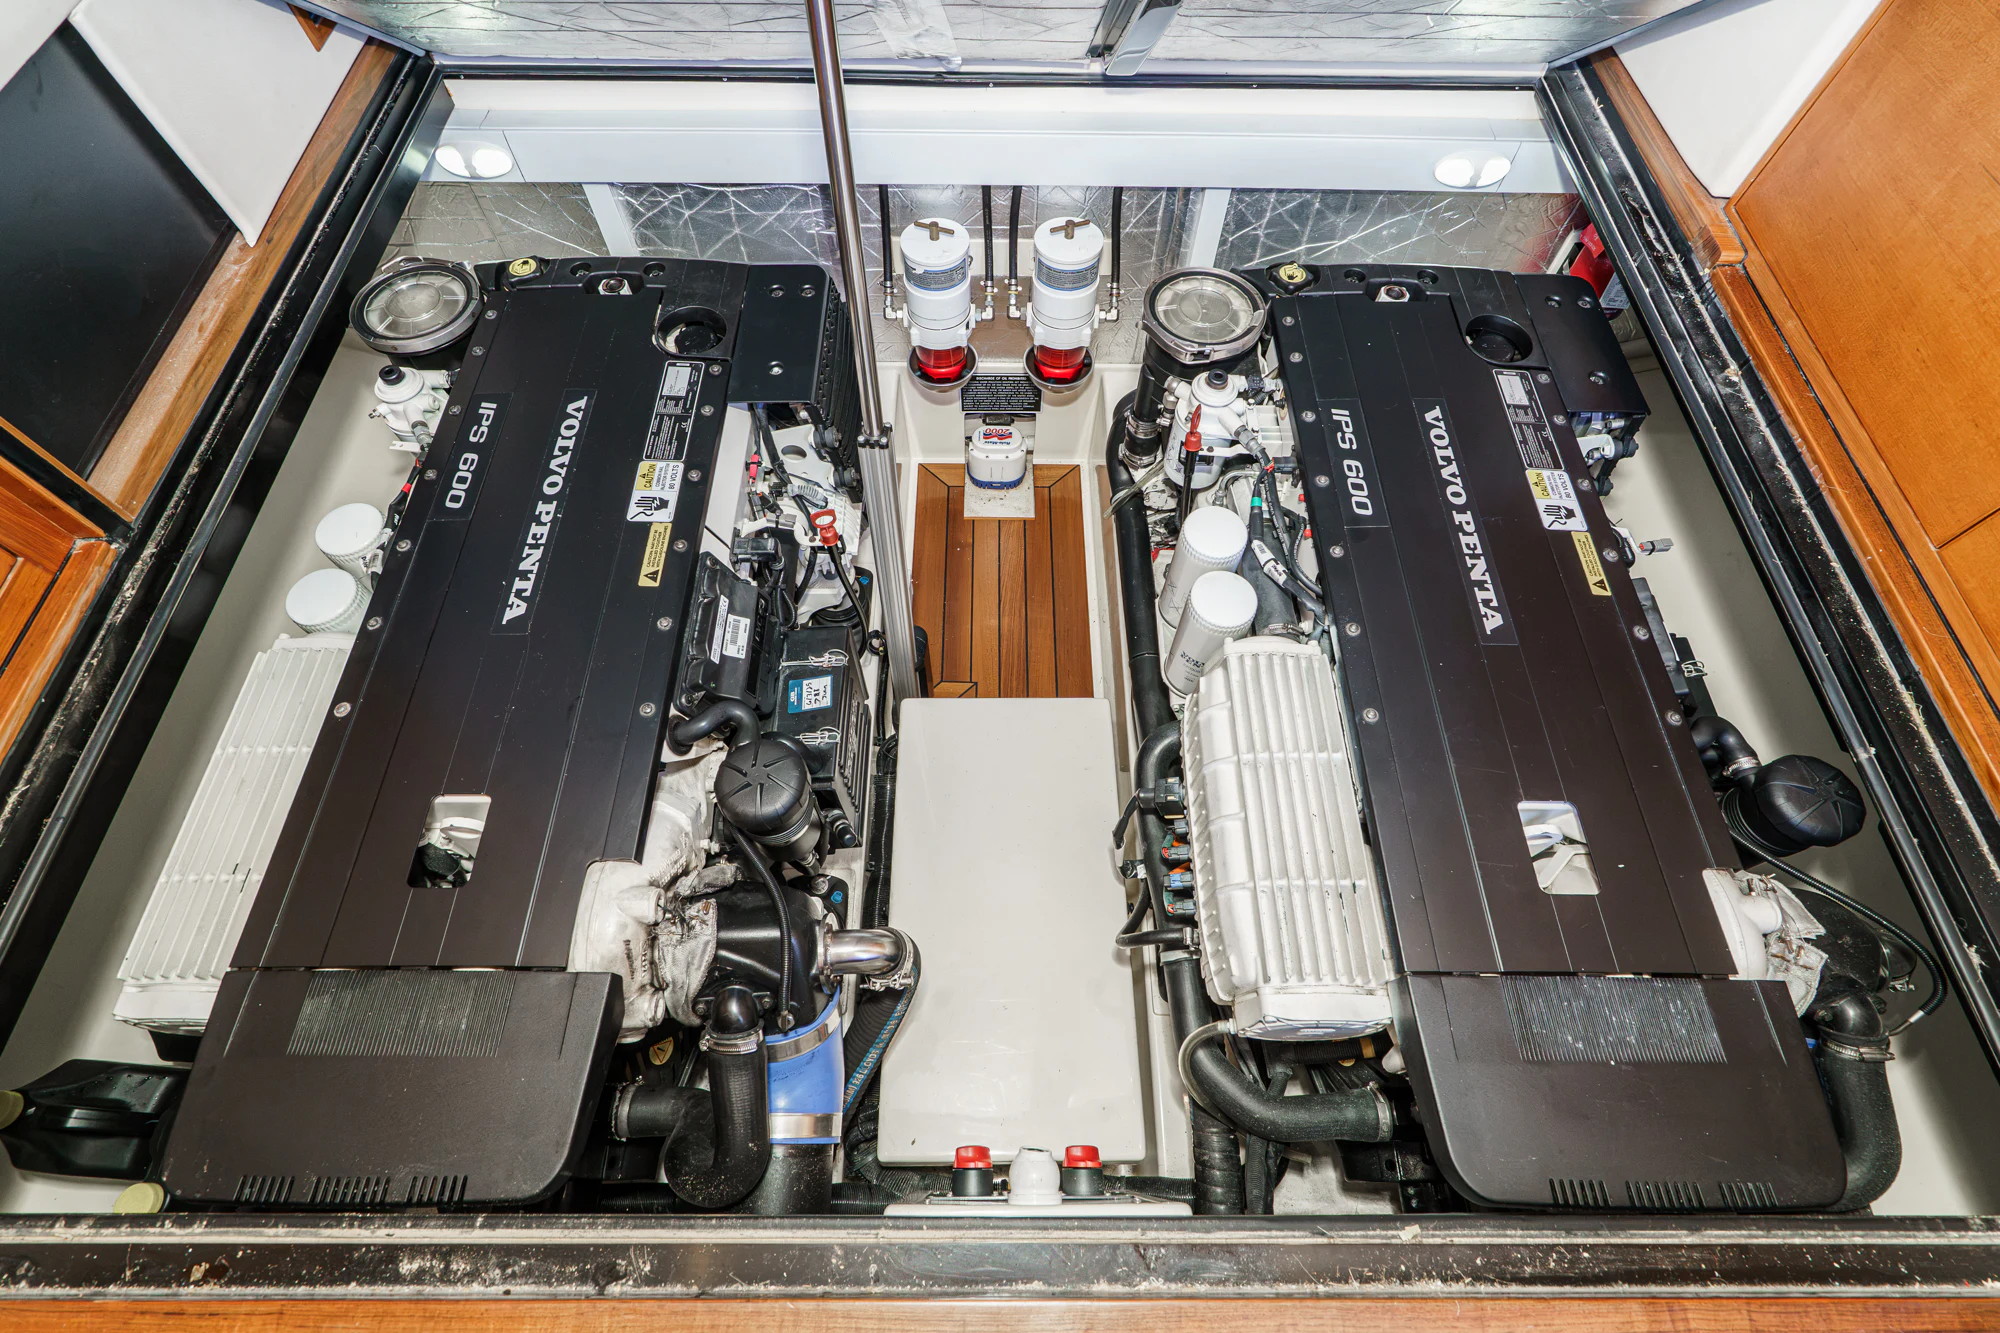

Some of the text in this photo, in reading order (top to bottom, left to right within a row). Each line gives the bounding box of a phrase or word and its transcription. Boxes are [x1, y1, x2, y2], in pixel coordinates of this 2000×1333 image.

[445, 402, 498, 509] IPS 600
[644, 463, 656, 488] CAUTION
[670, 464, 679, 482] VOLTS
[1331, 408, 1373, 516] IPS 600
[1535, 472, 1549, 497] CAUTION
[1558, 473, 1568, 491] VOLTS
[501, 396, 588, 625] VOLVO PENTA
[1424, 405, 1504, 635] VOLVO PENTA
